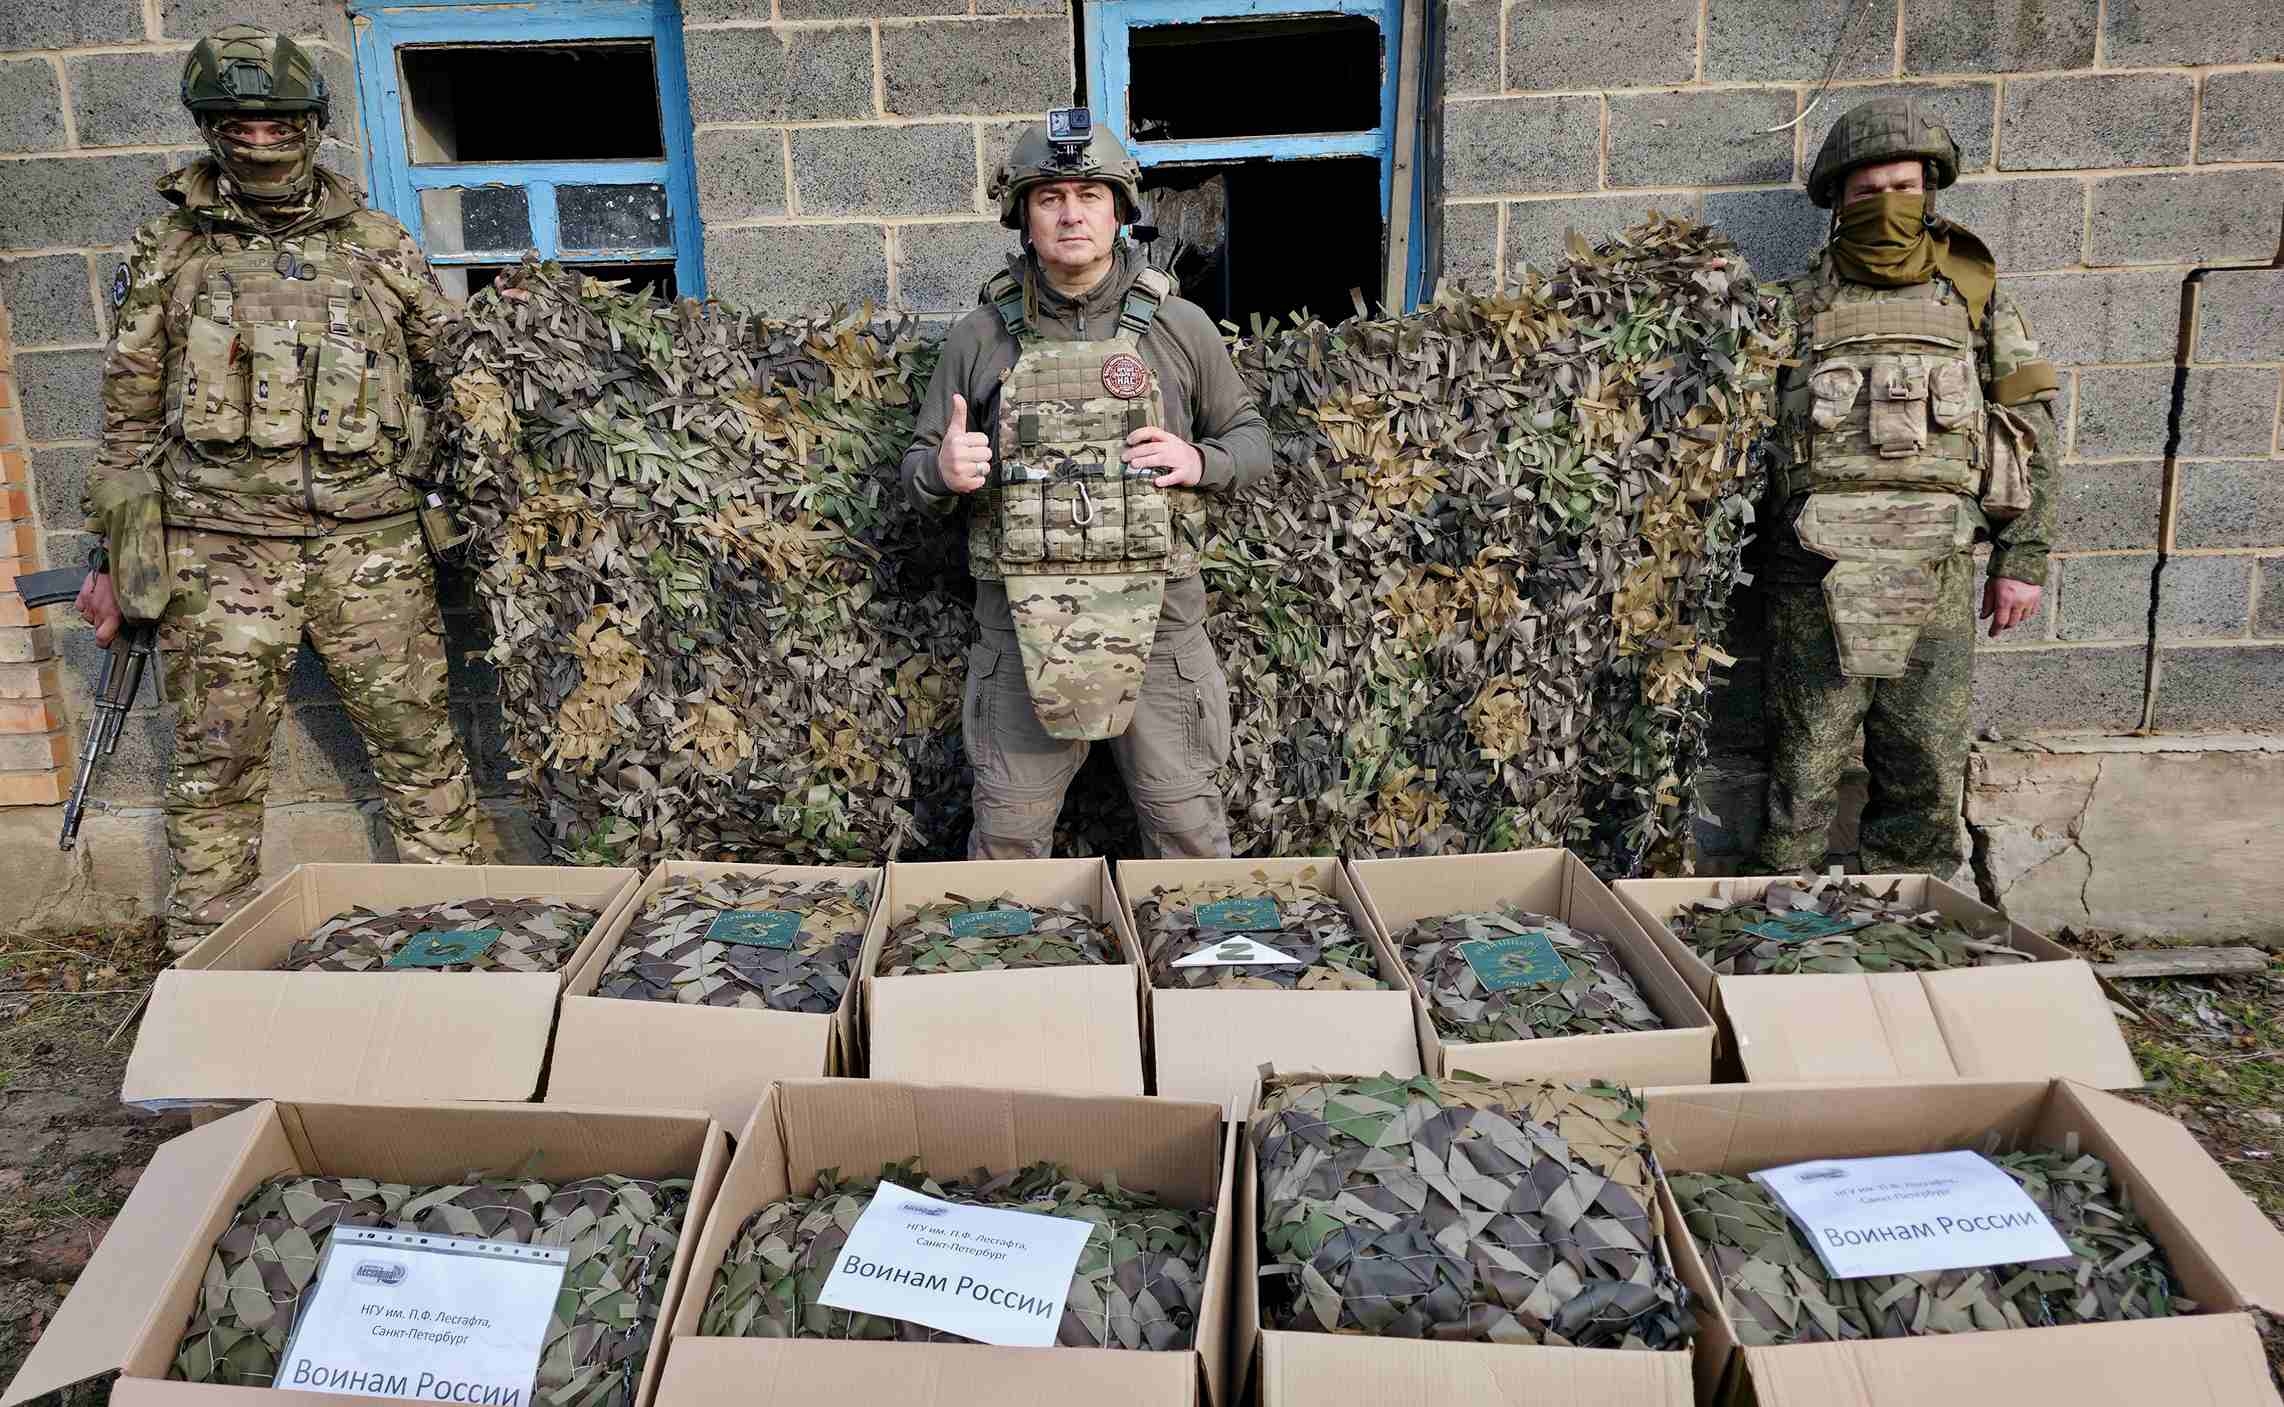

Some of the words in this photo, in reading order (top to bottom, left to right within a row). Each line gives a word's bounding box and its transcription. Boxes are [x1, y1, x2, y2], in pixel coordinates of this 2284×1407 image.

[906, 1222, 928, 1232] НГУ
[1824, 1222, 1936, 1247] Воинам
[1936, 1211, 2040, 1236] России
[915, 1237, 1007, 1261] Санкт-Петербург
[843, 1254, 948, 1293] Воинам
[955, 1275, 1054, 1320] России
[360, 1303, 385, 1318] НГУ
[385, 1306, 406, 1319] им.
[409, 1308, 433, 1321] П.Ф.
[435, 1311, 491, 1329] Лесгафта,
[371, 1325, 468, 1345] Санкт-Петербург
[293, 1358, 407, 1396] Воинам
[415, 1371, 522, 1407] России
